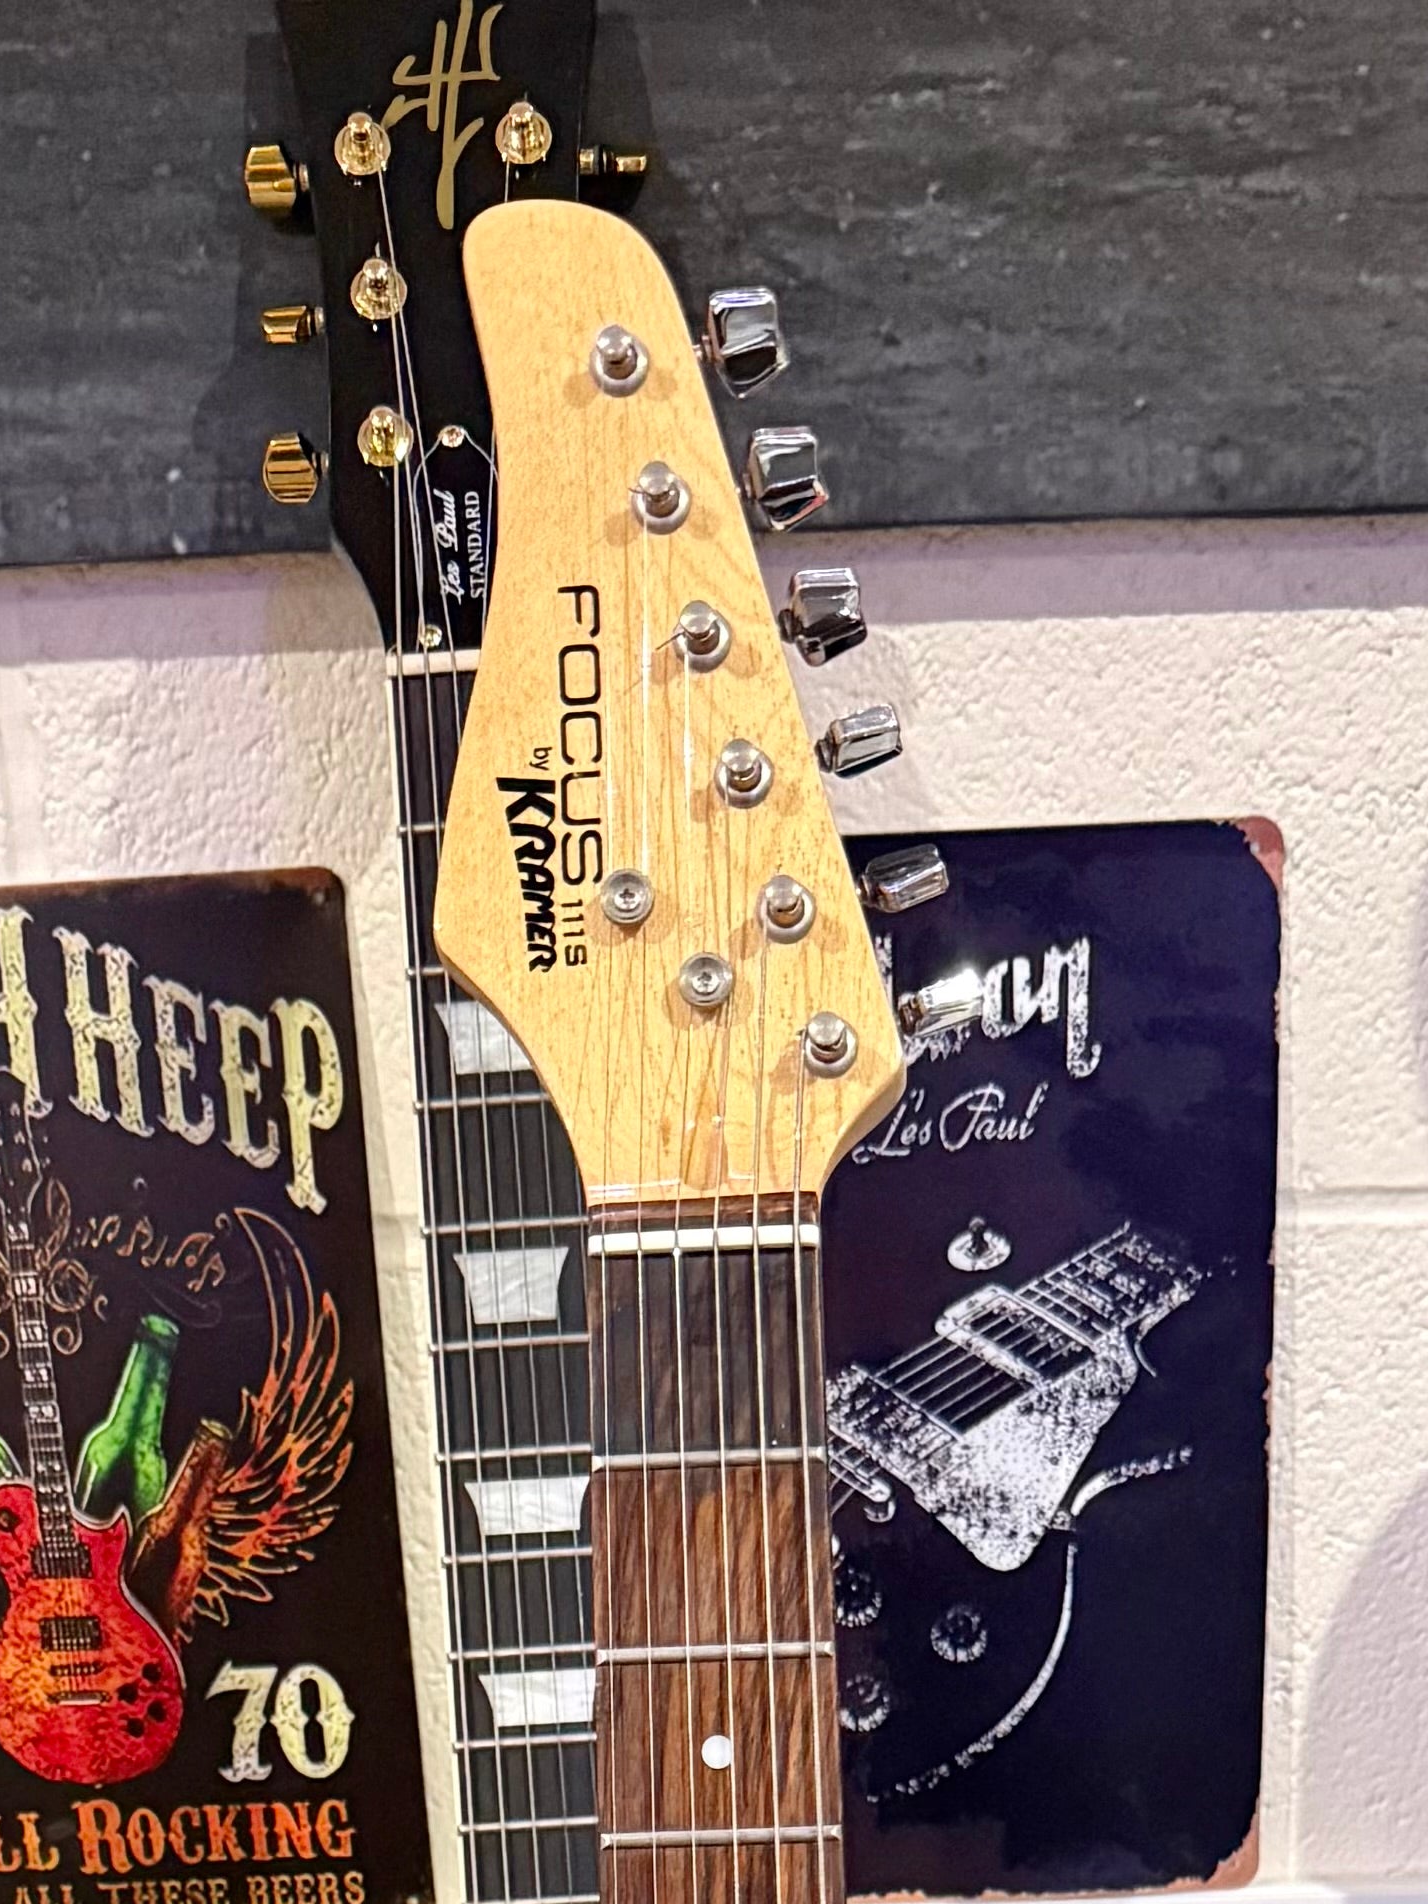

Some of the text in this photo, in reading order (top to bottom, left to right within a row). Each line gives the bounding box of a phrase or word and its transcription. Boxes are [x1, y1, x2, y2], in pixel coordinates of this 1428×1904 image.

[465, 488, 486, 600] STANDARD
[529, 745, 554, 770] by
[557, 584, 604, 886] FOCUS
[495, 776, 558, 974] KRAMER
[51, 924, 348, 1214] HEEP
[204, 1660, 358, 1785] 70
